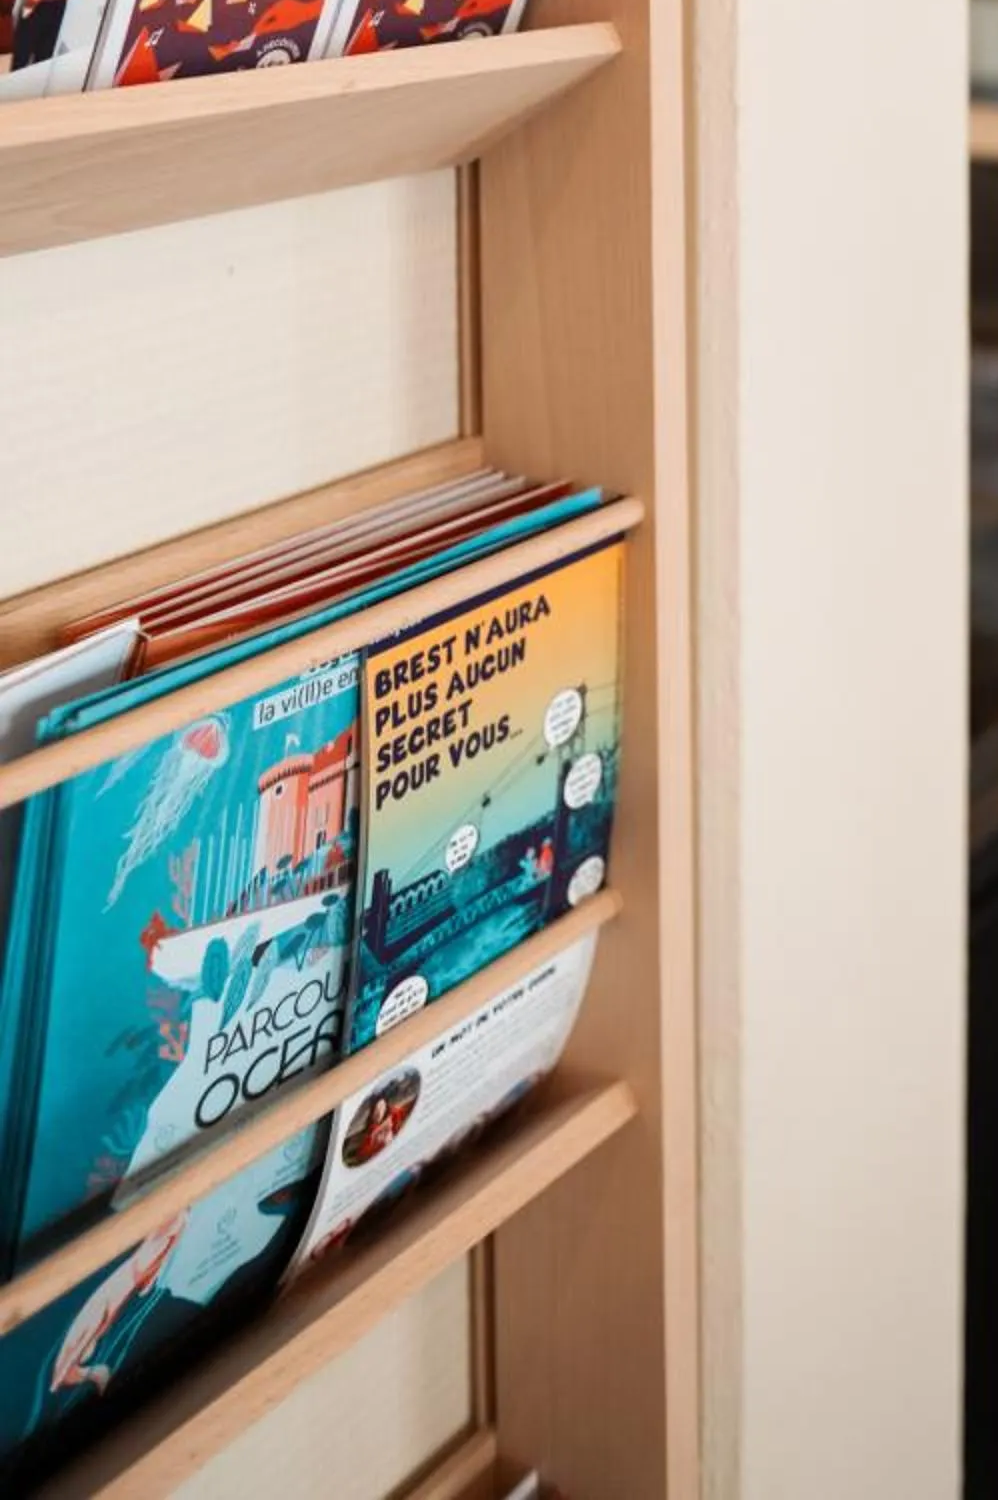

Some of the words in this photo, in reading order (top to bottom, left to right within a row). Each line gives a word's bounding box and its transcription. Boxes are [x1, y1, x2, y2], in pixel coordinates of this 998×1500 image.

[375, 636, 457, 700] BREST
[465, 595, 550, 655] N'AURA
[259, 701, 275, 724] la
[281, 678, 333, 713] vi(ll)e
[376, 682, 437, 737] PLUS
[446, 637, 526, 700] AUCUN
[377, 698, 473, 773] SECRET
[376, 753, 440, 811] POUR
